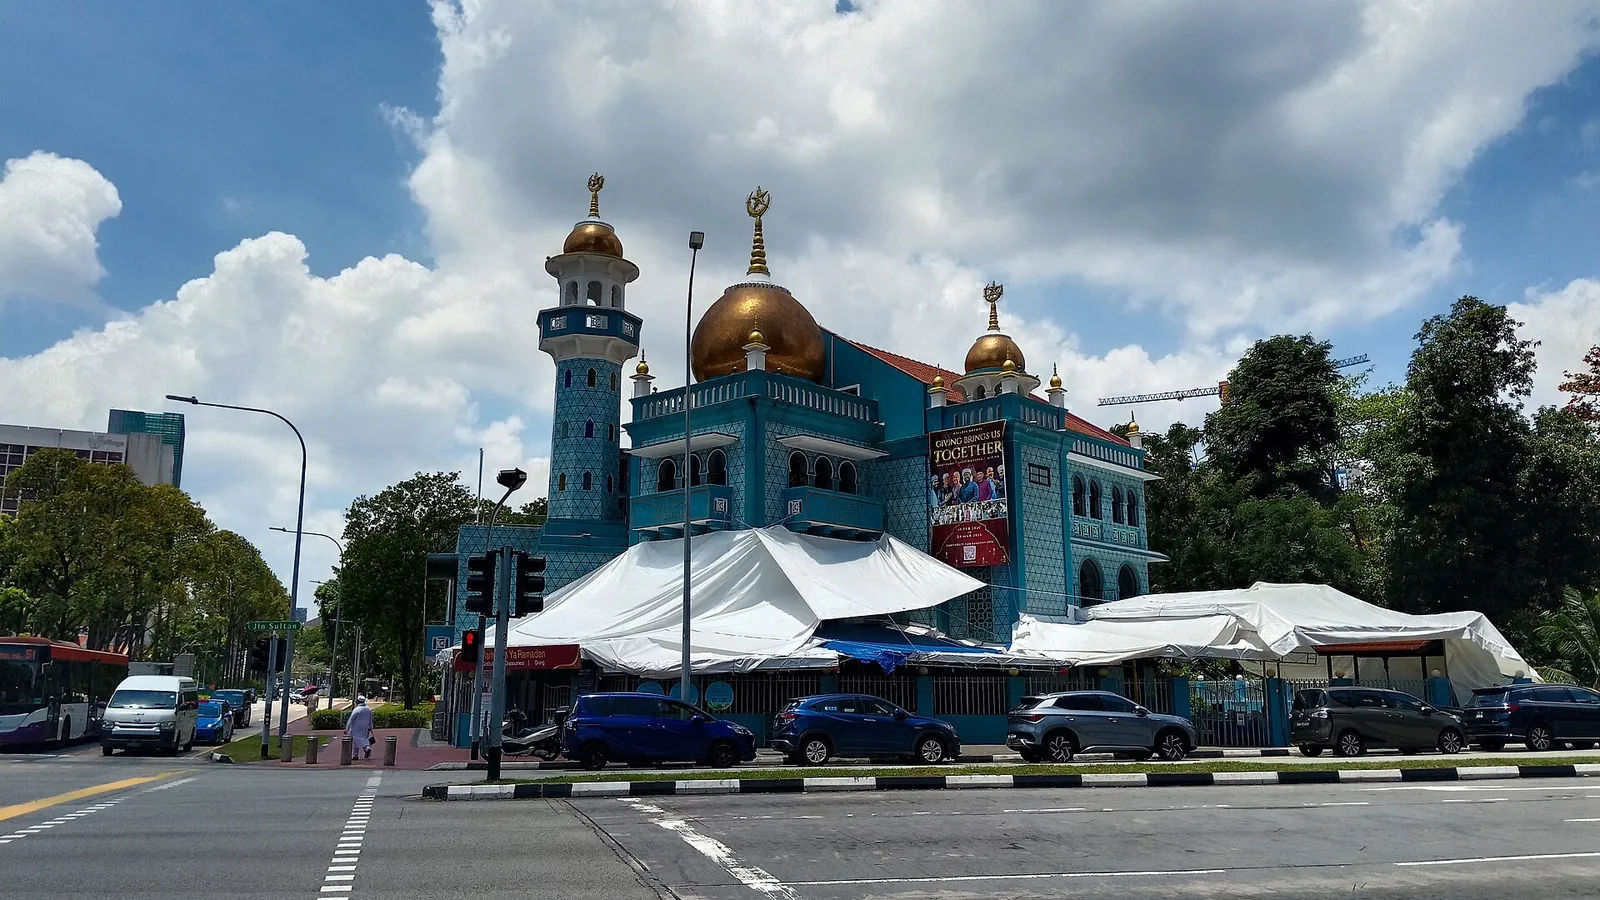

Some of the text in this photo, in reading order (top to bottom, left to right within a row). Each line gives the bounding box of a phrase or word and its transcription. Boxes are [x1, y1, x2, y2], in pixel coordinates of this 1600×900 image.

[935, 436, 963, 448] GIVING
[964, 432, 990, 444] BRINGS
[990, 429, 1001, 439] US
[933, 440, 1003, 463] TOGETHER
[253, 622, 297, 630] Jln Sultan
[517, 648, 546, 659] Ramadan
